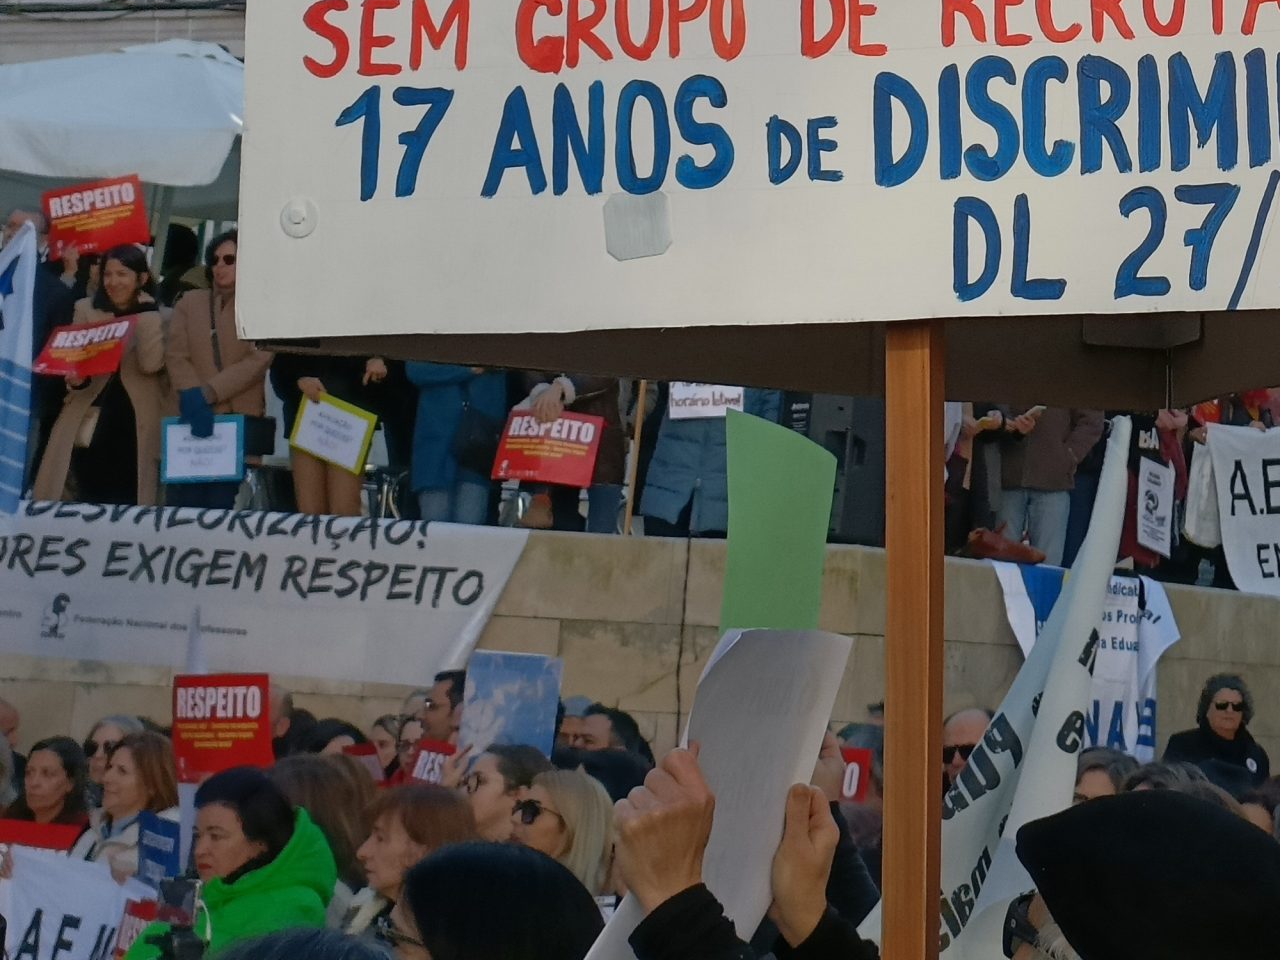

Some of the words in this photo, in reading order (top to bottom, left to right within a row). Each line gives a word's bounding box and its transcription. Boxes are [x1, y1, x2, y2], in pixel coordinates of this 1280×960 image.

[336, 85, 455, 202] 17
[480, 74, 736, 199] ANOS
[766, 113, 844, 185] DE
[49, 182, 134, 218] RESPEITO
[953, 191, 1067, 301] DL
[52, 320, 129, 348] RESPEITO
[508, 415, 596, 444] RESPEITO
[102, 541, 268, 592] EXIGEM
[280, 555, 485, 608] RESPEITO
[125, 616, 168, 631] Nacional
[169, 620, 188, 633] dos
[176, 685, 261, 719] RESPEITO
